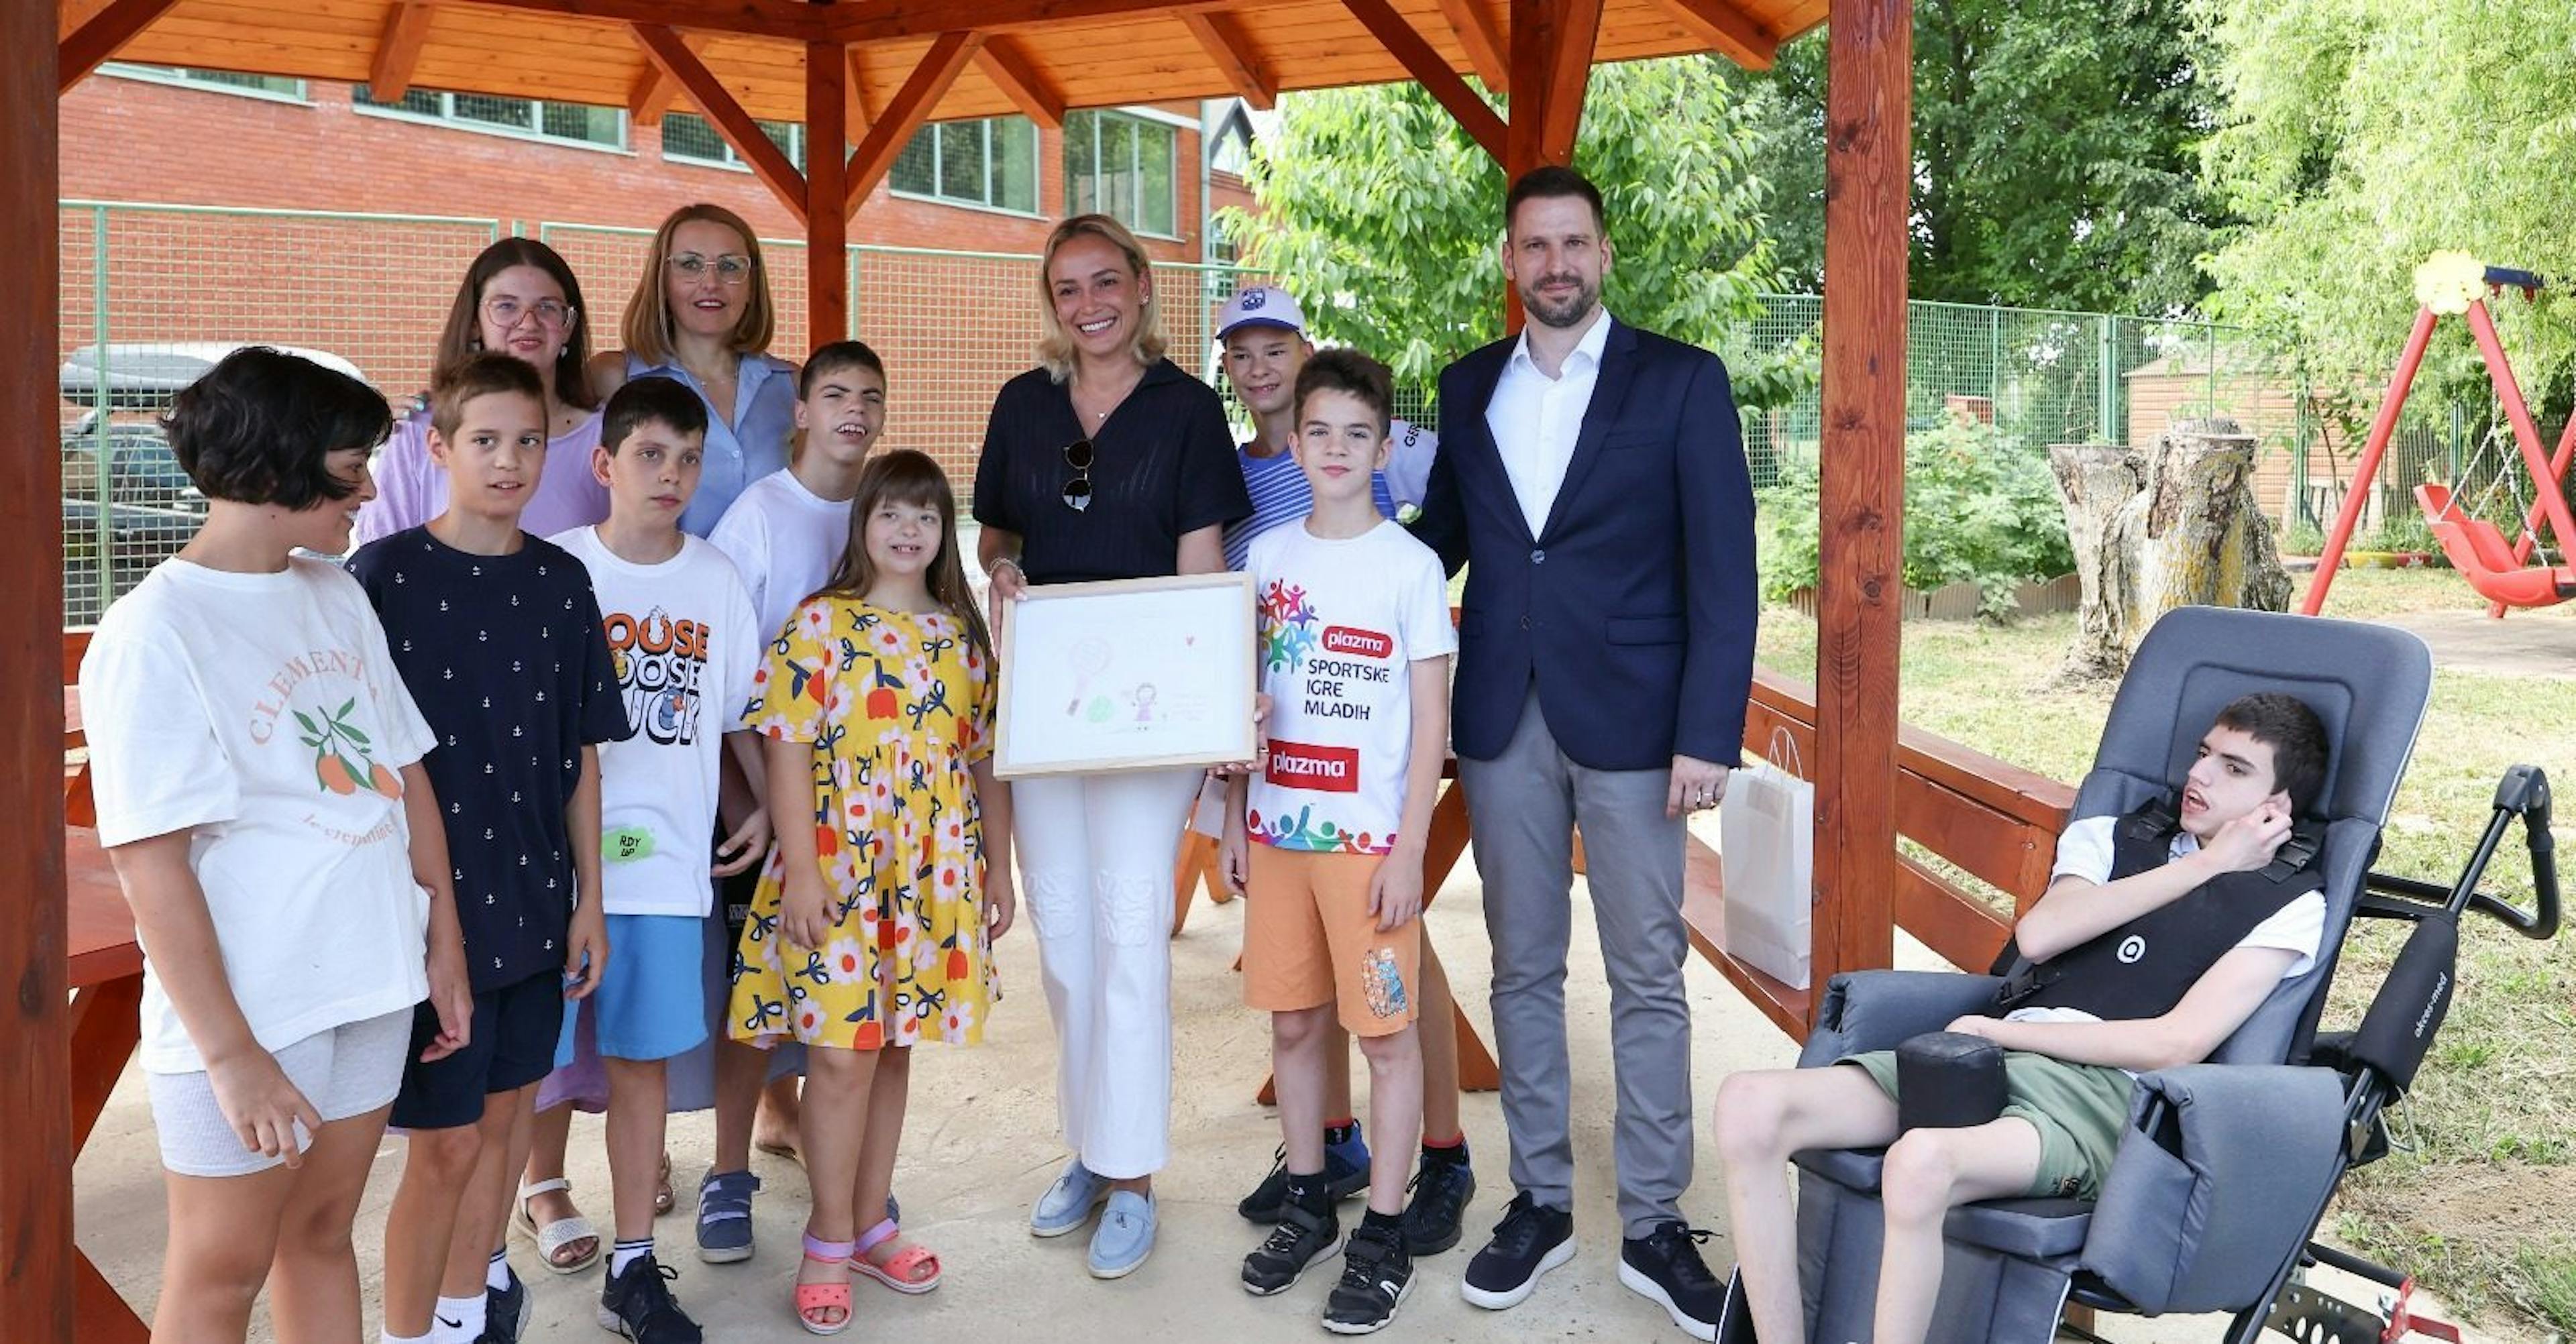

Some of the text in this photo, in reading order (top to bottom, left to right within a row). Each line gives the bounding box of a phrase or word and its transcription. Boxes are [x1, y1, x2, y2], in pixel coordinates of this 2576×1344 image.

[604, 612, 709, 663] OOSE
[1328, 630, 1384, 653] plazma
[1309, 659, 1390, 683] SPORTSKE
[1307, 679, 1344, 697] IGRE
[1305, 699, 1371, 720] MLADIH
[1273, 750, 1346, 777] plazma
